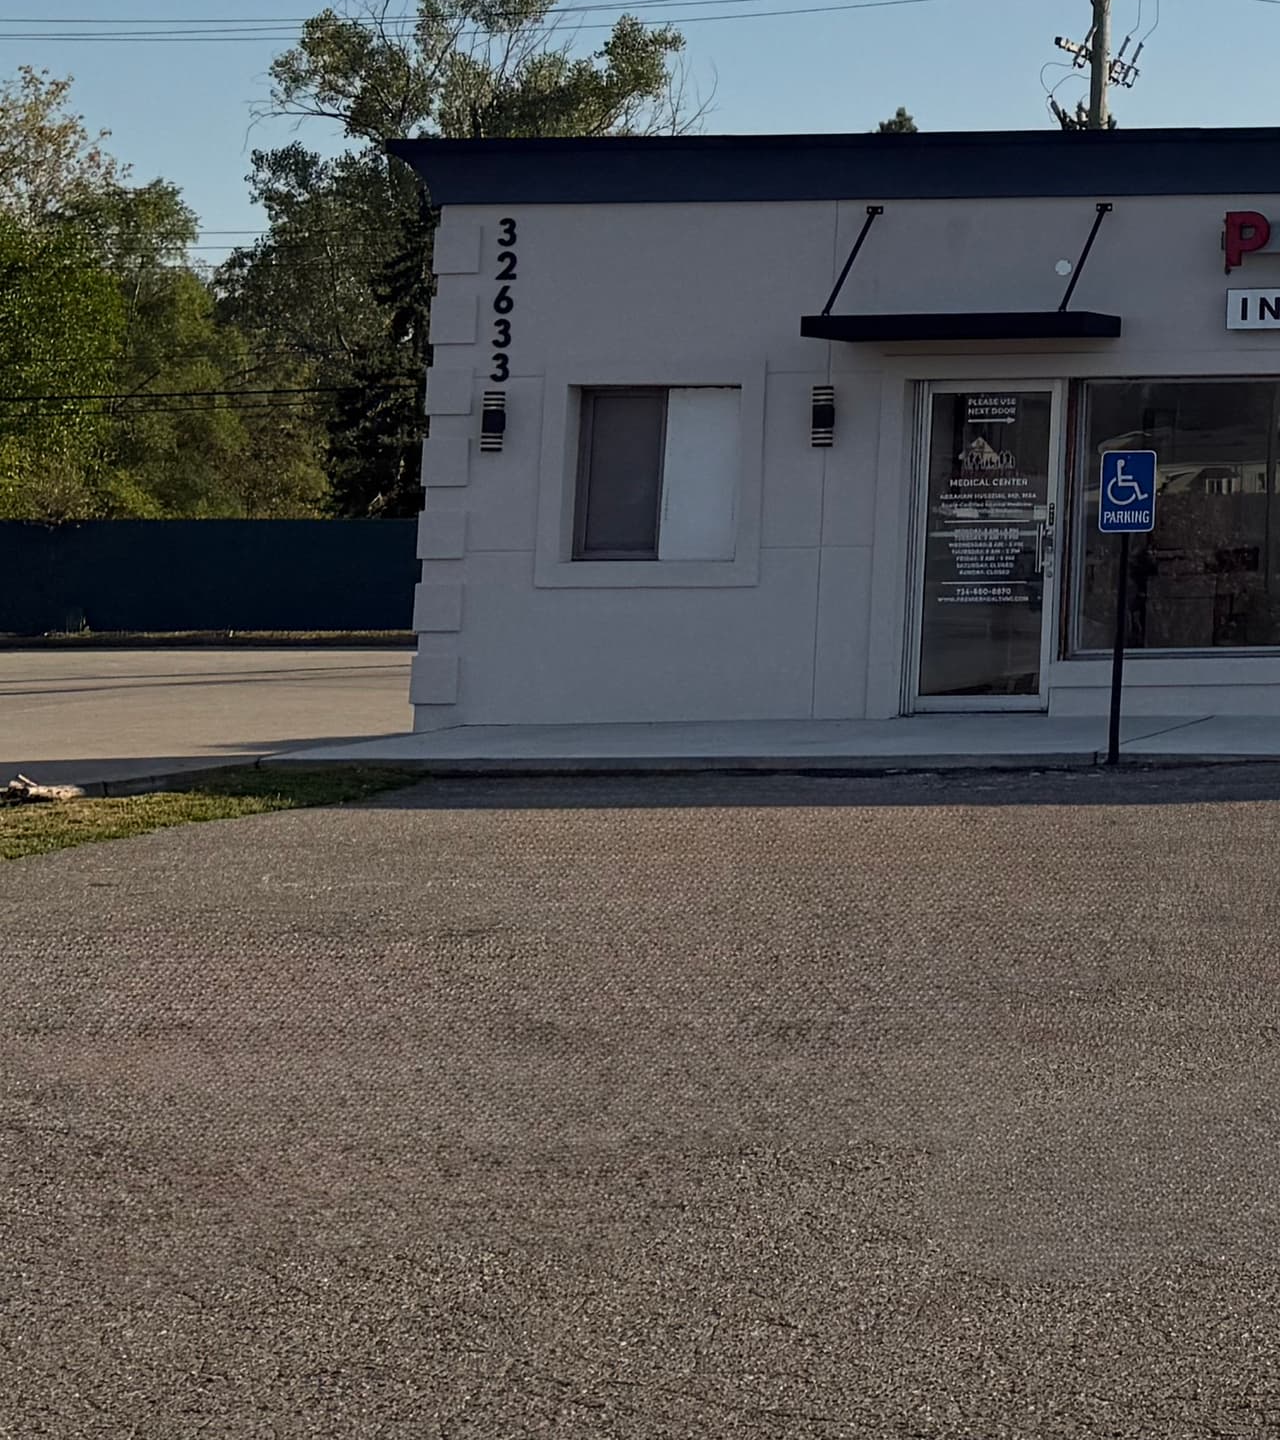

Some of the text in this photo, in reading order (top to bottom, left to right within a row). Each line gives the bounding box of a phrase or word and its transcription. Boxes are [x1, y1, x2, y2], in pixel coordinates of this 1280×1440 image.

[490, 217, 518, 382] 32633
[968, 397, 999, 406] PLEASE
[968, 407, 1016, 416] NEXT DOOR
[949, 478, 1028, 487] MEDICAL CENTER
[1103, 510, 1150, 524] PARKING
